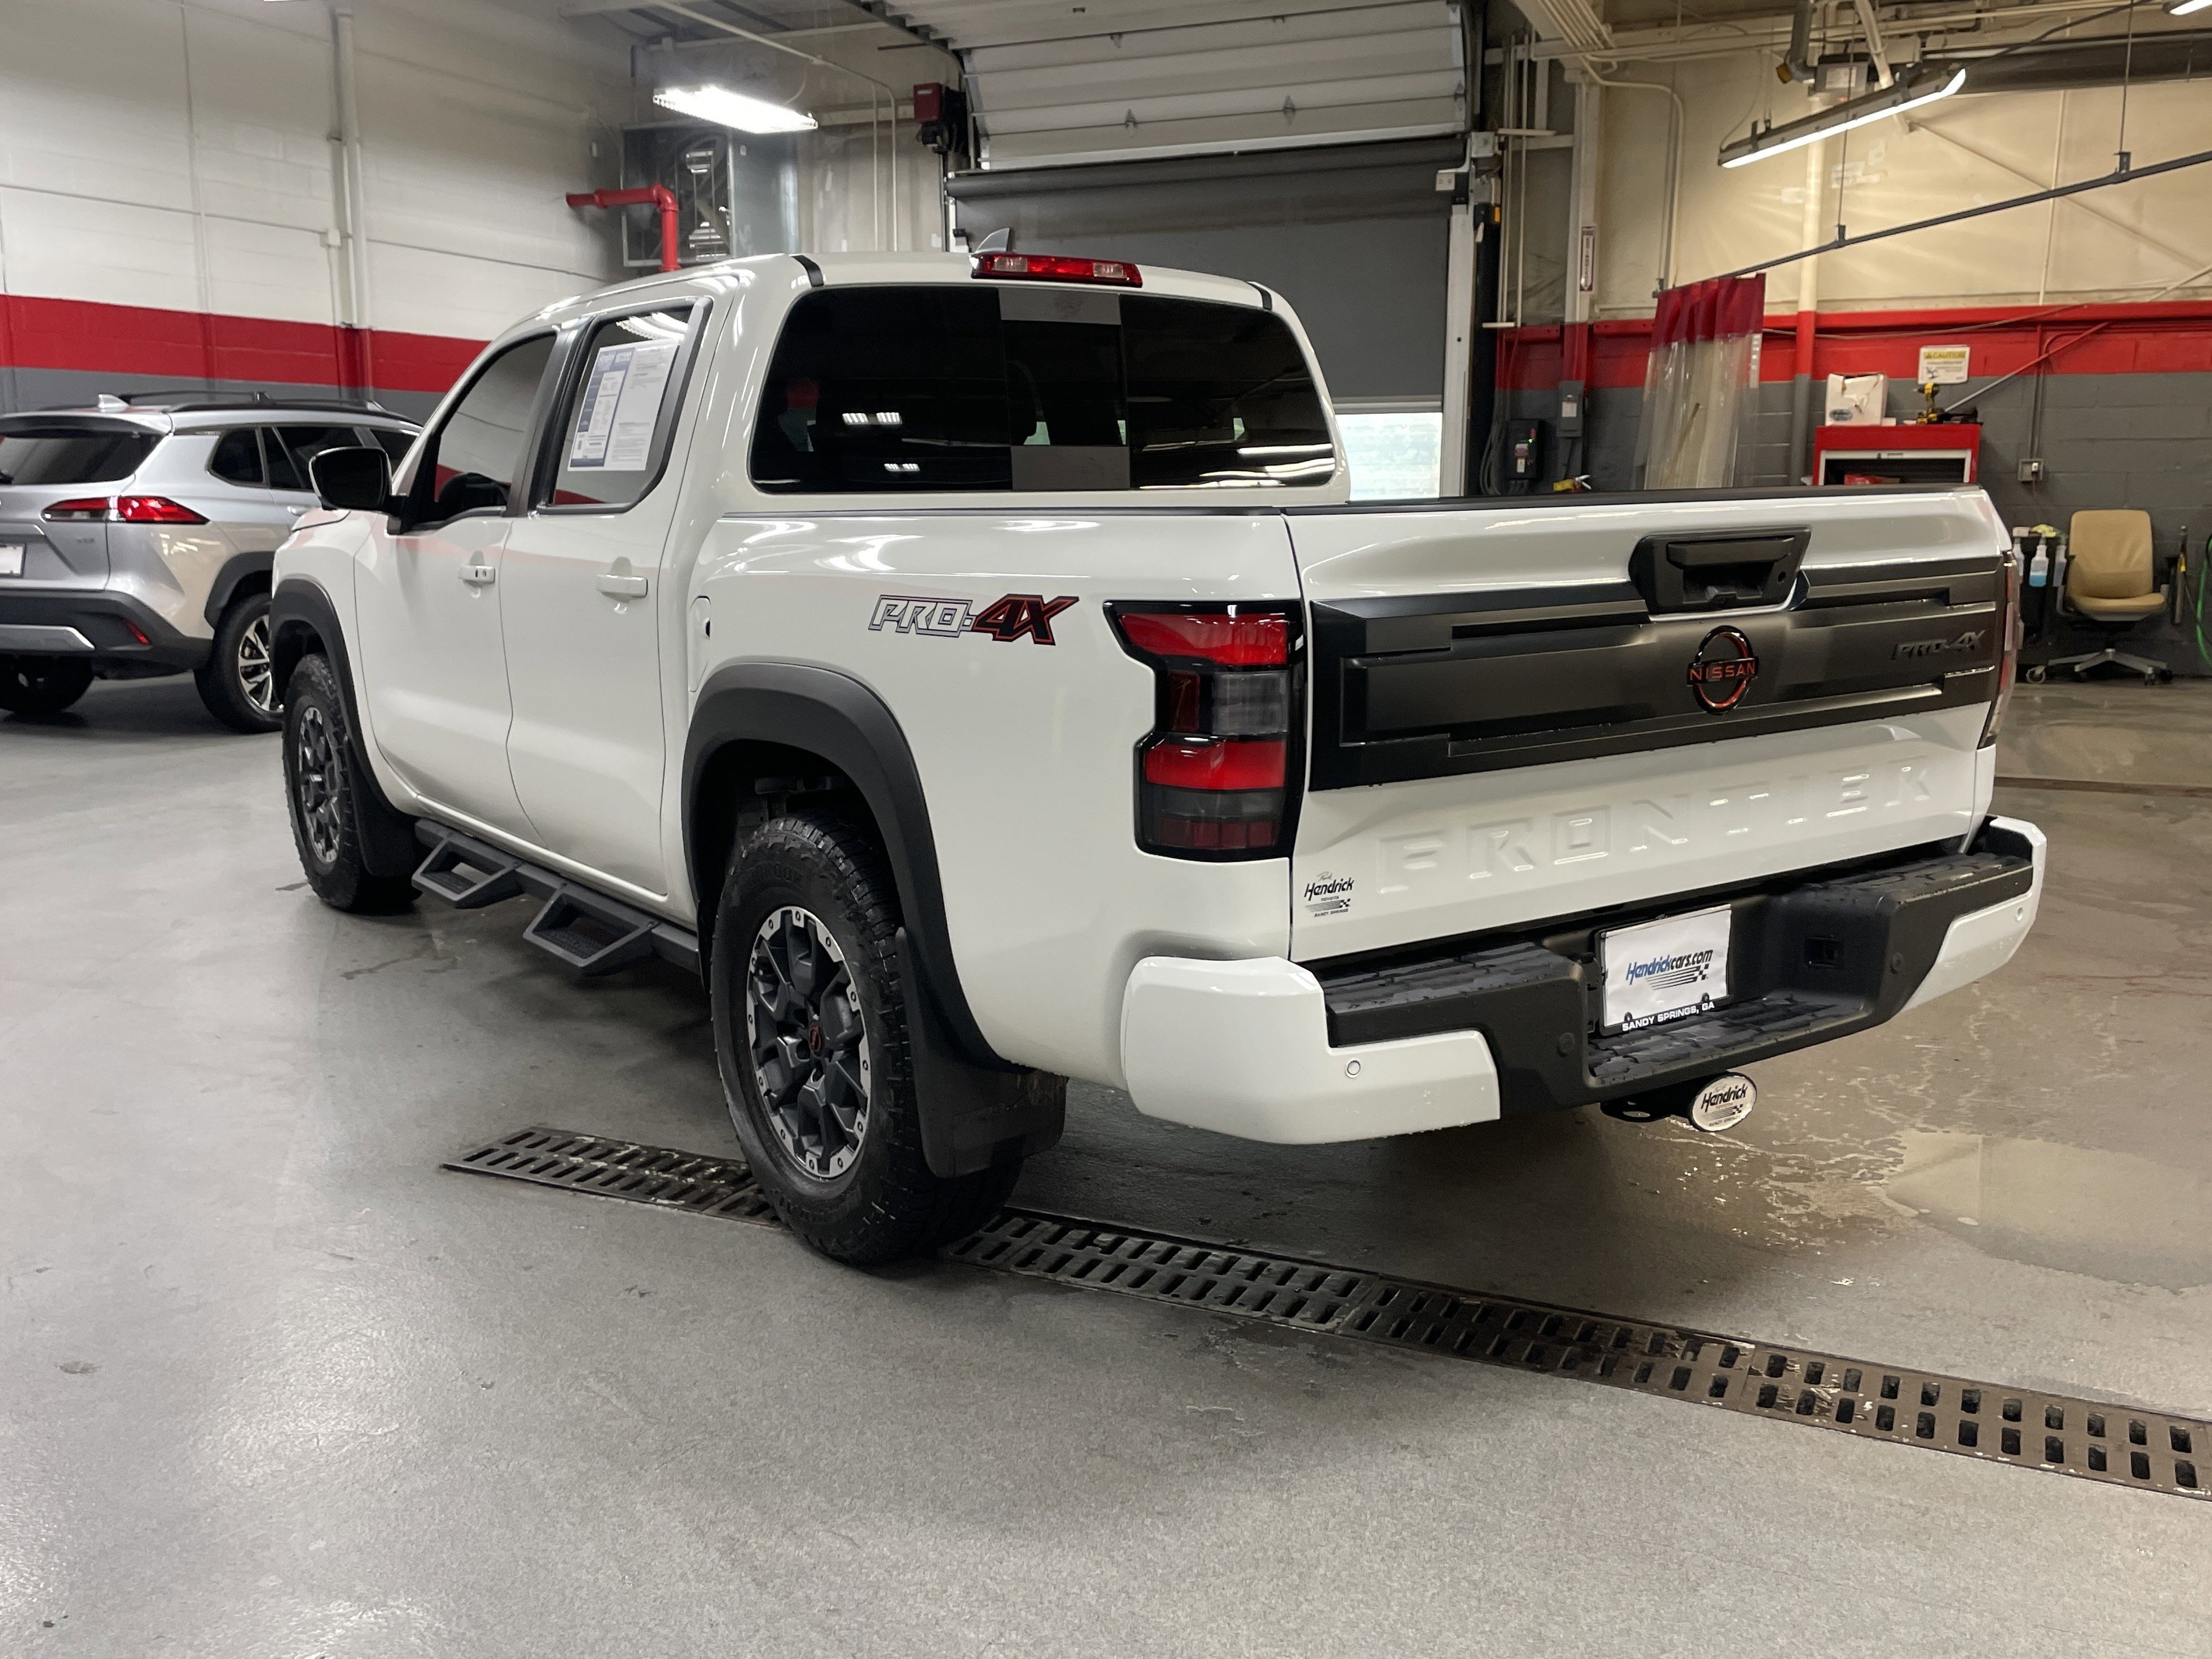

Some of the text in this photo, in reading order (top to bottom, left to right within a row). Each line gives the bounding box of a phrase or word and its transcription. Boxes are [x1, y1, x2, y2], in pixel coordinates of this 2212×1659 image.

[868, 594, 1079, 645] PRO-4X
[1892, 630, 1985, 659] PRO-4X
[1690, 662, 1755, 680] NISSAN
[1377, 755, 1932, 894] FRONTIER
[1304, 877, 1355, 901] Hendrick
[1626, 949, 1713, 985] Hendrickcars.com
[1622, 1001, 1715, 1031] SANDY SPRINGS, GA
[1701, 1083, 1748, 1113] Hendrick
